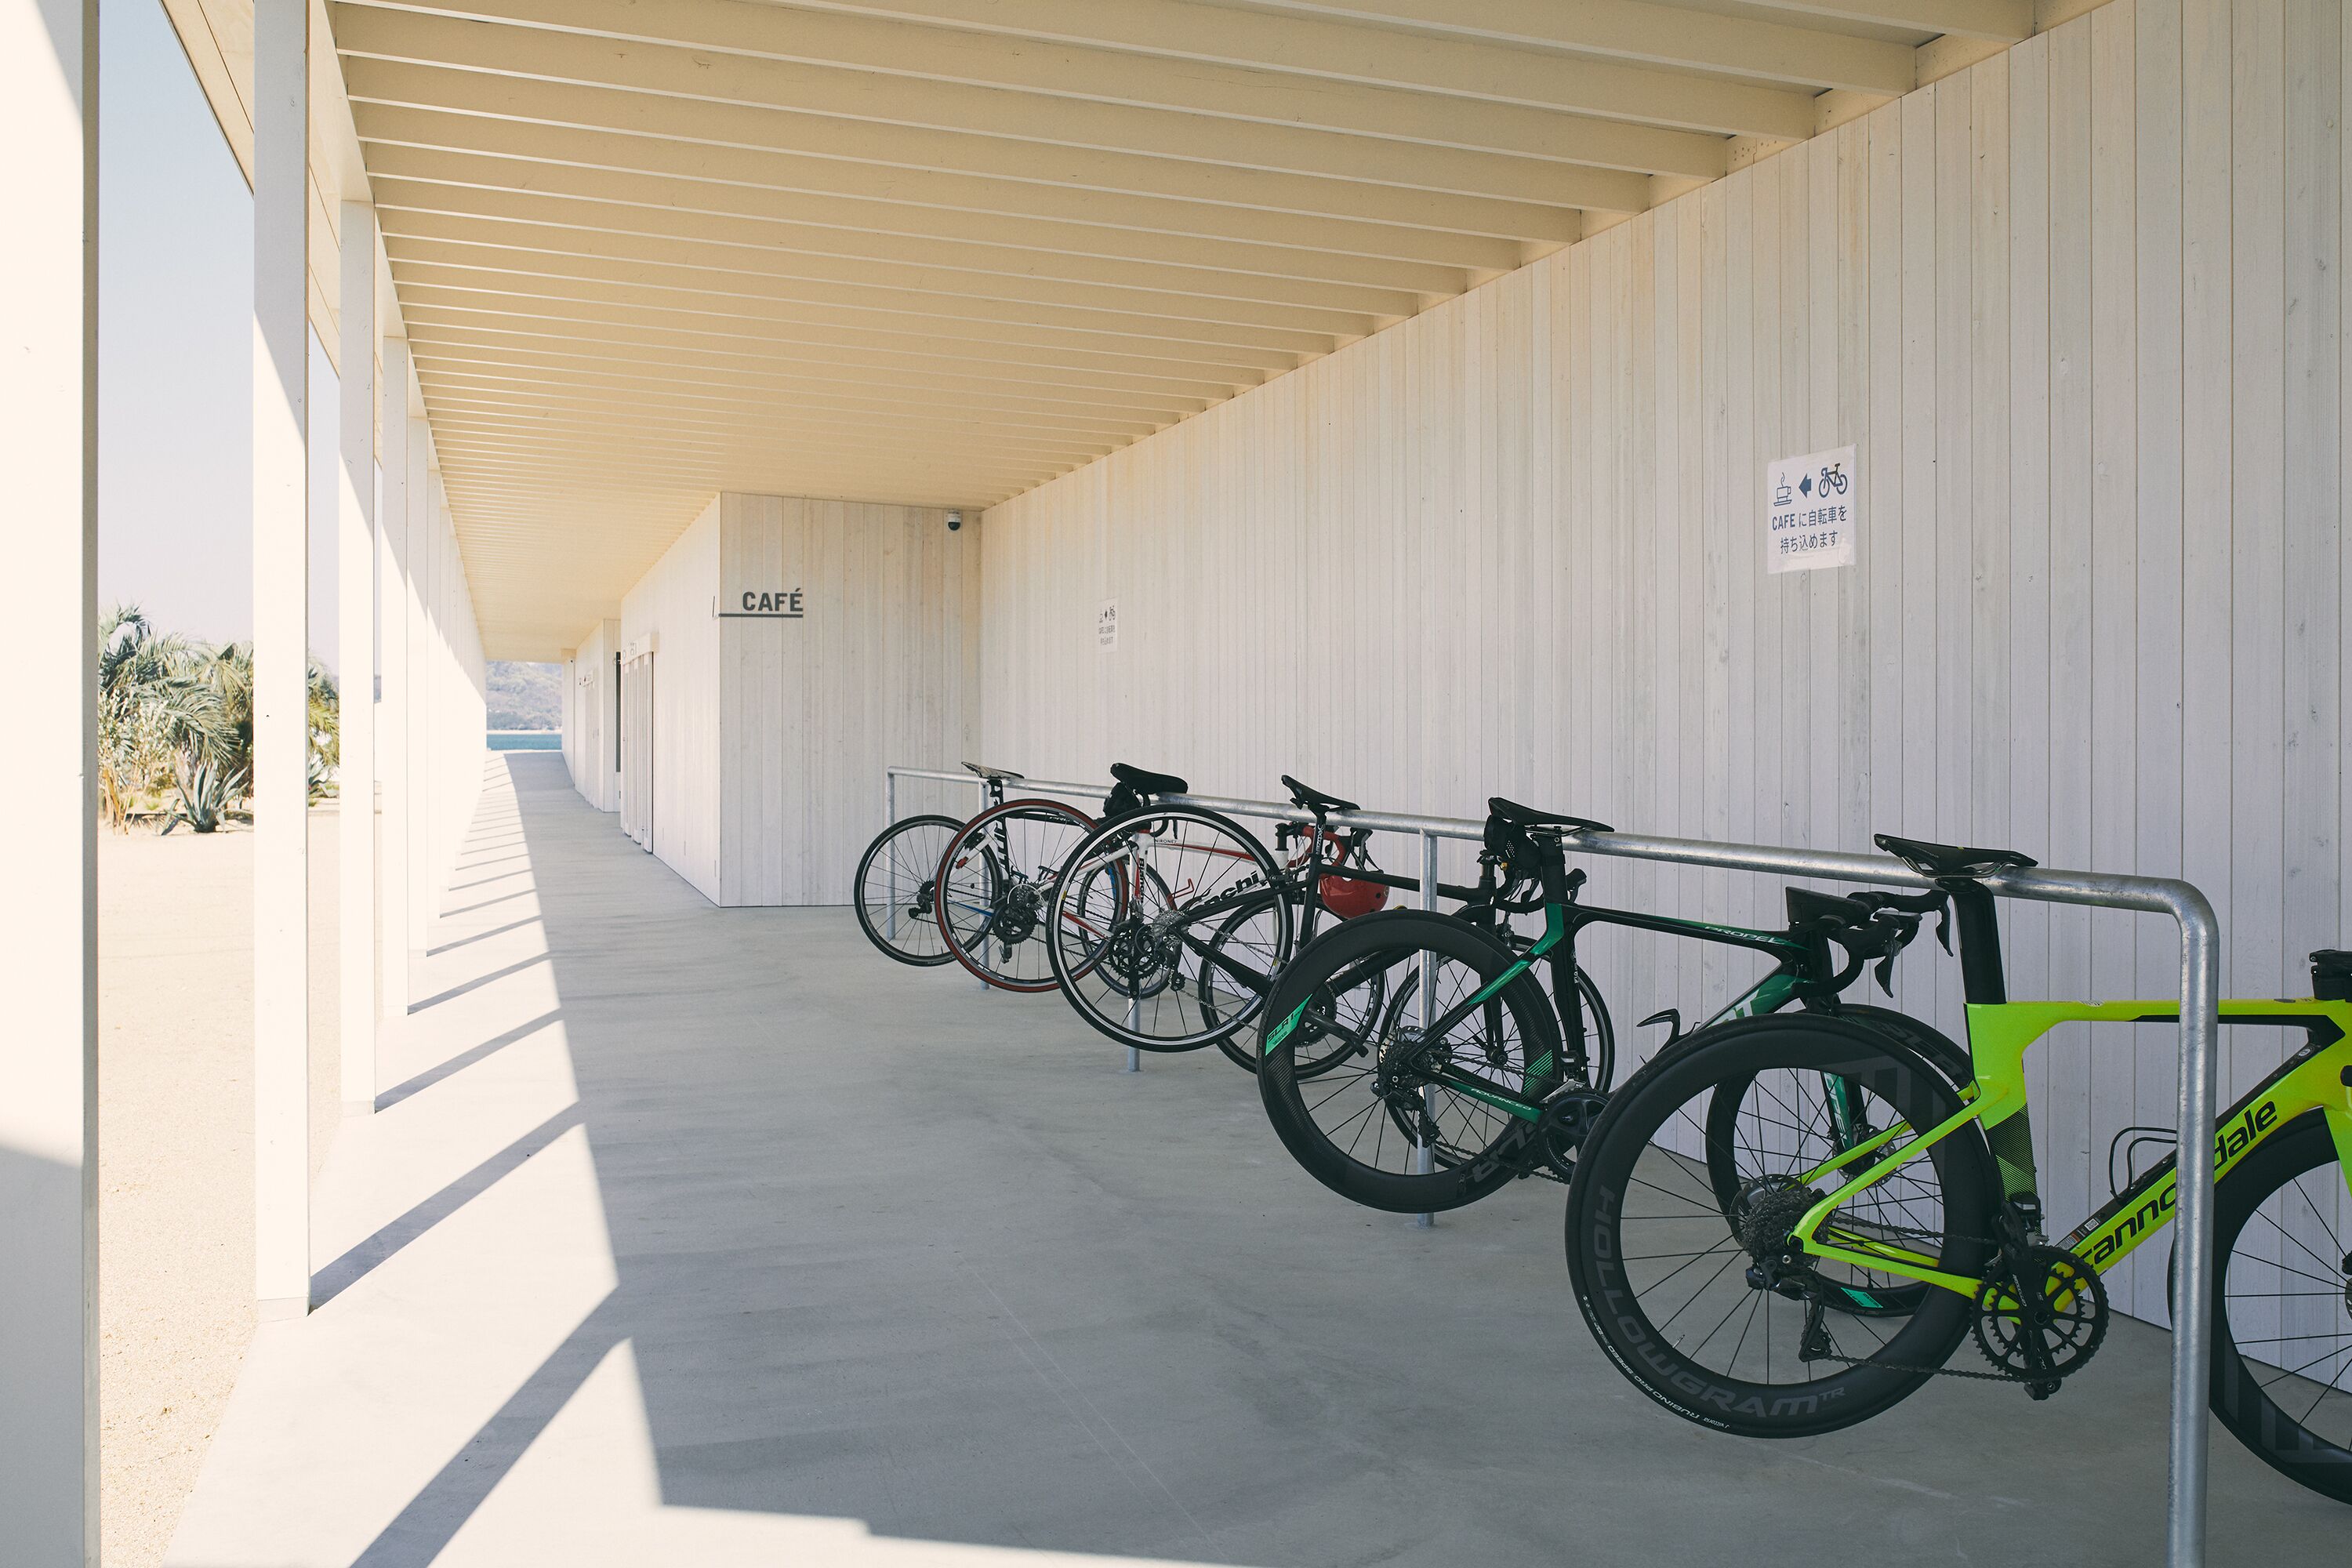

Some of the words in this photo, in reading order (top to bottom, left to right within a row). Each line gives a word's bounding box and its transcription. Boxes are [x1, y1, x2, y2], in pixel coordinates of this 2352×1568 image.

[1772, 514, 1795, 531] CAFE
[1798, 505, 1847, 528] に自転車を
[1780, 530, 1838, 554] 持ち込めます
[742, 587, 804, 612] CAFÉ
[1704, 926, 1786, 946] PROPEL
[1471, 1088, 1532, 1111] ADVANCED
[1824, 1072, 1848, 1151] OPEL
[1593, 1185, 1818, 1417] HOLLOWGRAM
[1818, 1387, 1846, 1401] TR
[1607, 1345, 1634, 1375] SPEED
[1634, 1375, 1653, 1392] PRO
[1653, 1391, 1700, 1419] RUBINO
